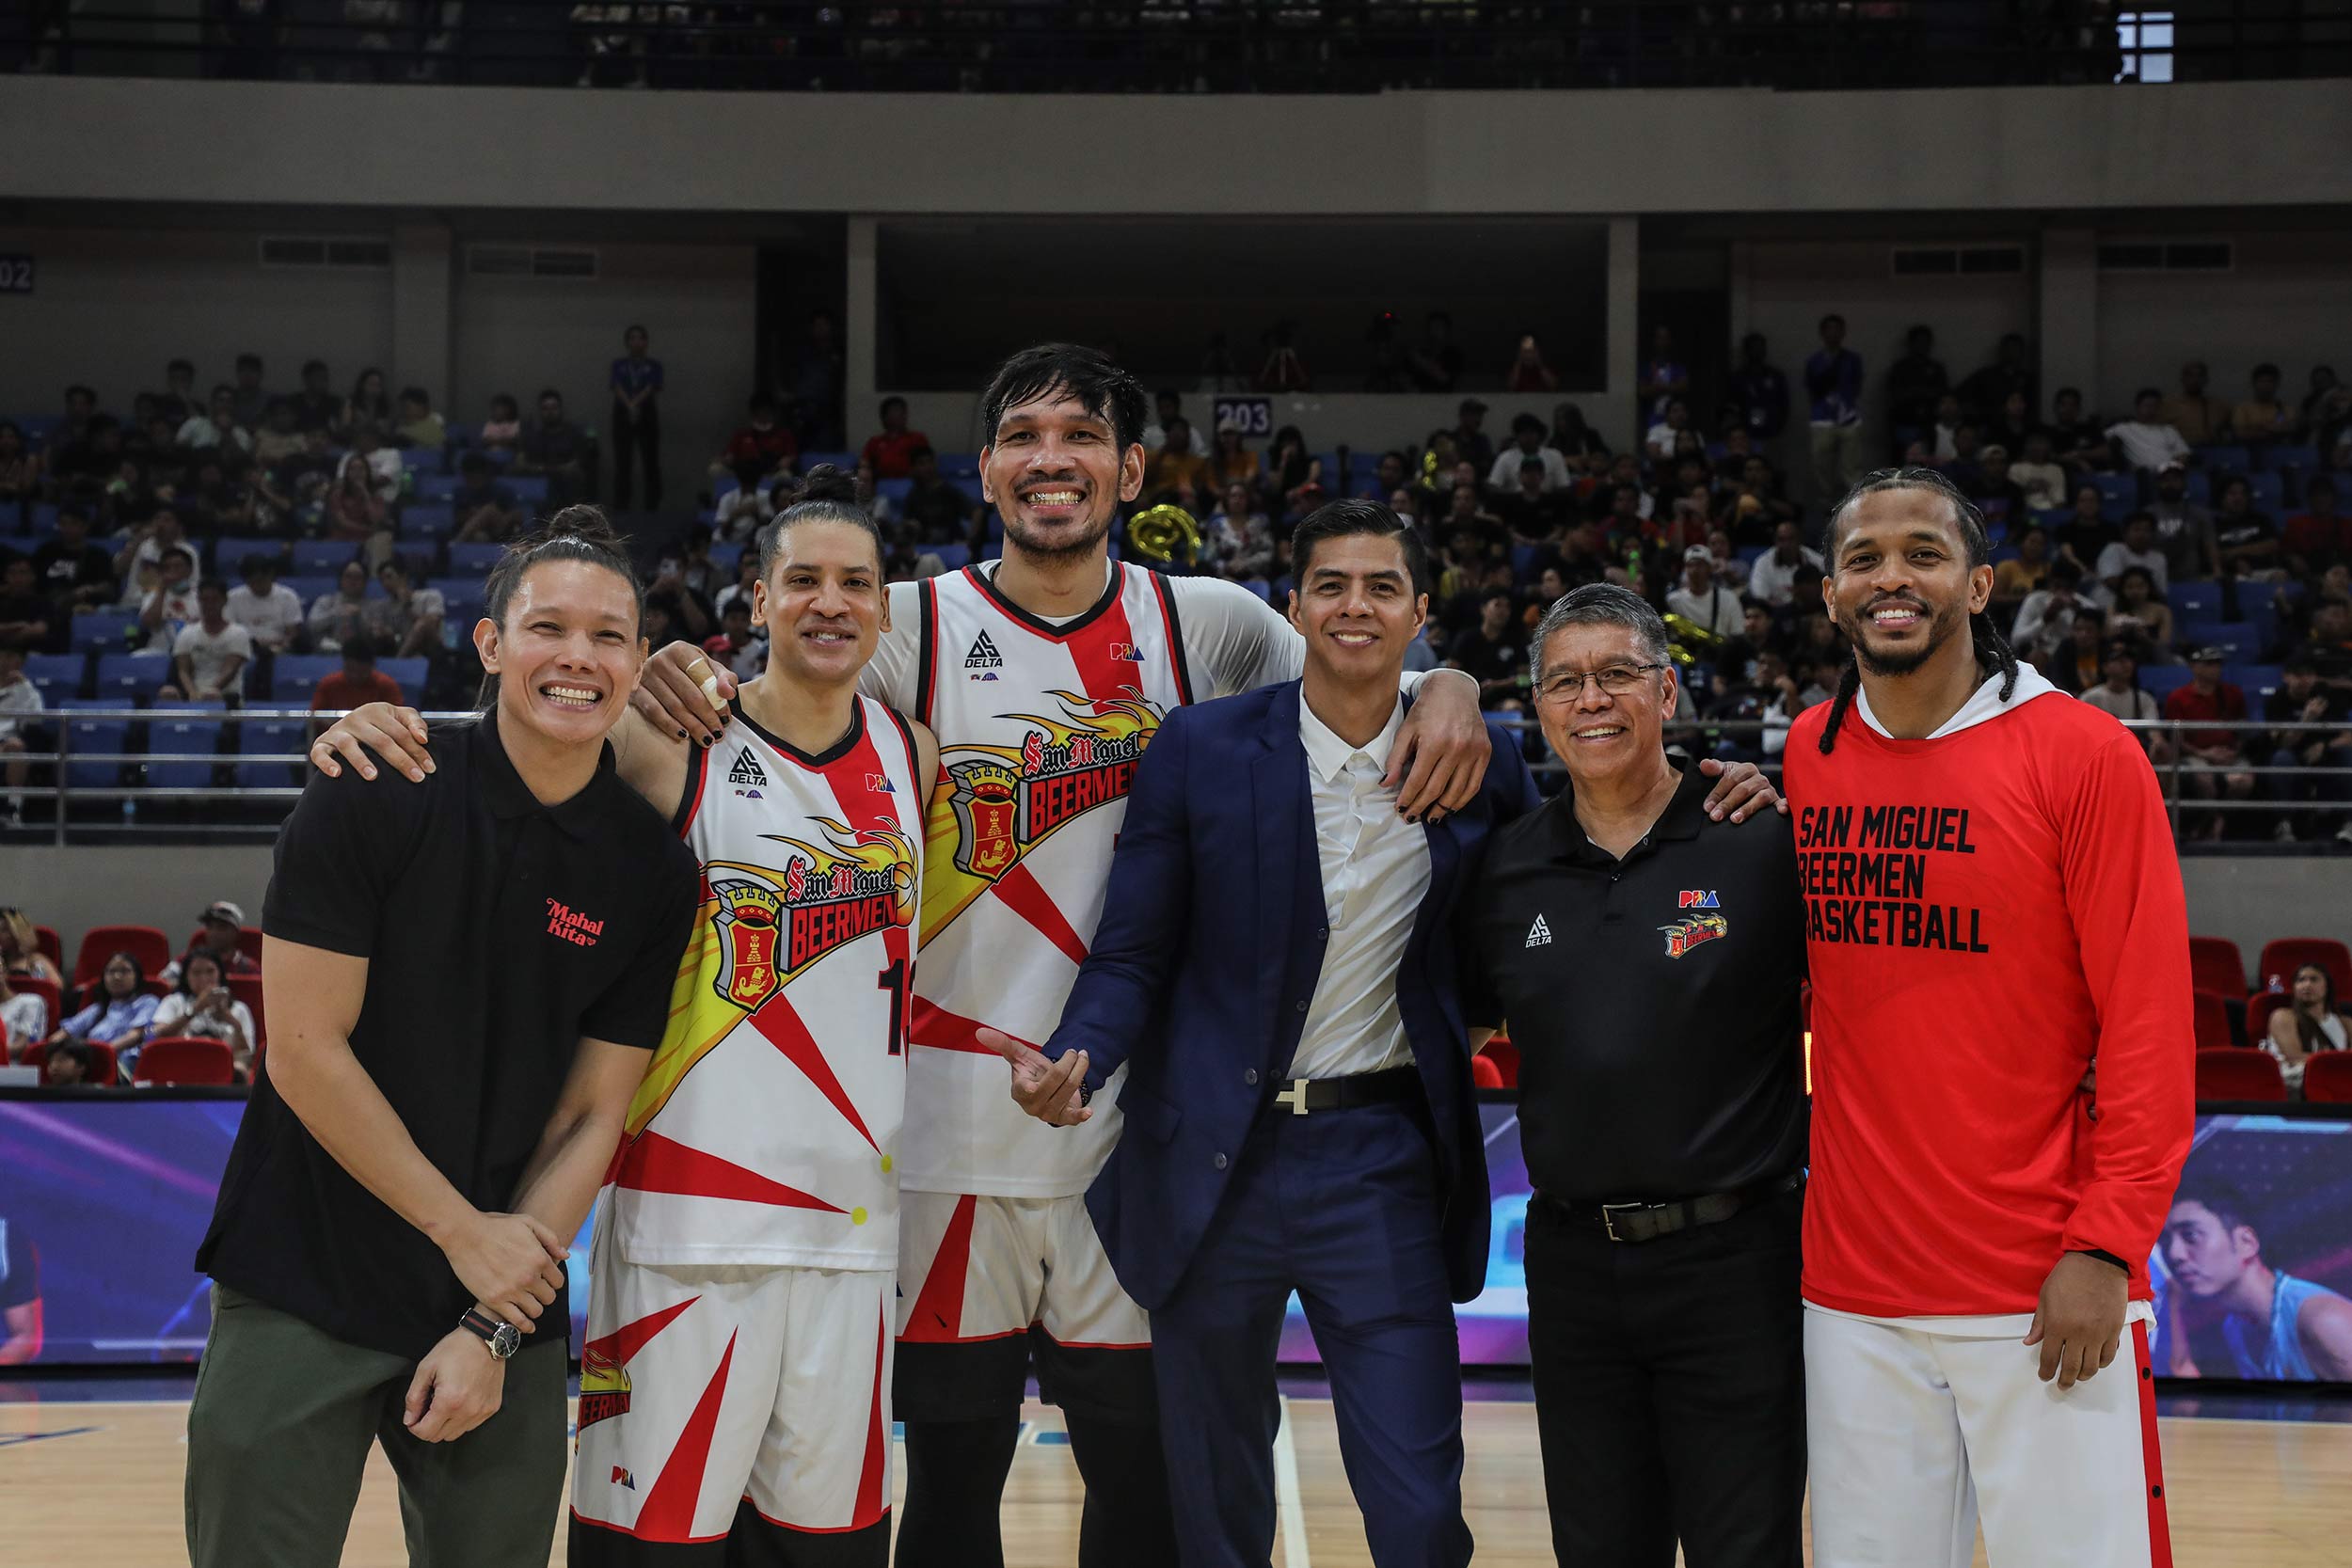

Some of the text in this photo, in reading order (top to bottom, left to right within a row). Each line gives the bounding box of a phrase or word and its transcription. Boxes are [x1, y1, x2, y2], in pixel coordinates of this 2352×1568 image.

[1218, 403, 1268, 433] 203
[964, 657, 1003, 669] DELTA
[1025, 732, 1140, 776] San Miguel
[728, 773, 768, 787] DELTA
[1799, 805, 1976, 853] SAN MIGUEL
[787, 857, 895, 902] San Miguel
[1798, 851, 1927, 899] BEERMEN
[546, 897, 605, 936] Mahal
[547, 918, 586, 946] Kita
[790, 894, 898, 969] BEERMEN
[1525, 935, 1552, 949] DELTA
